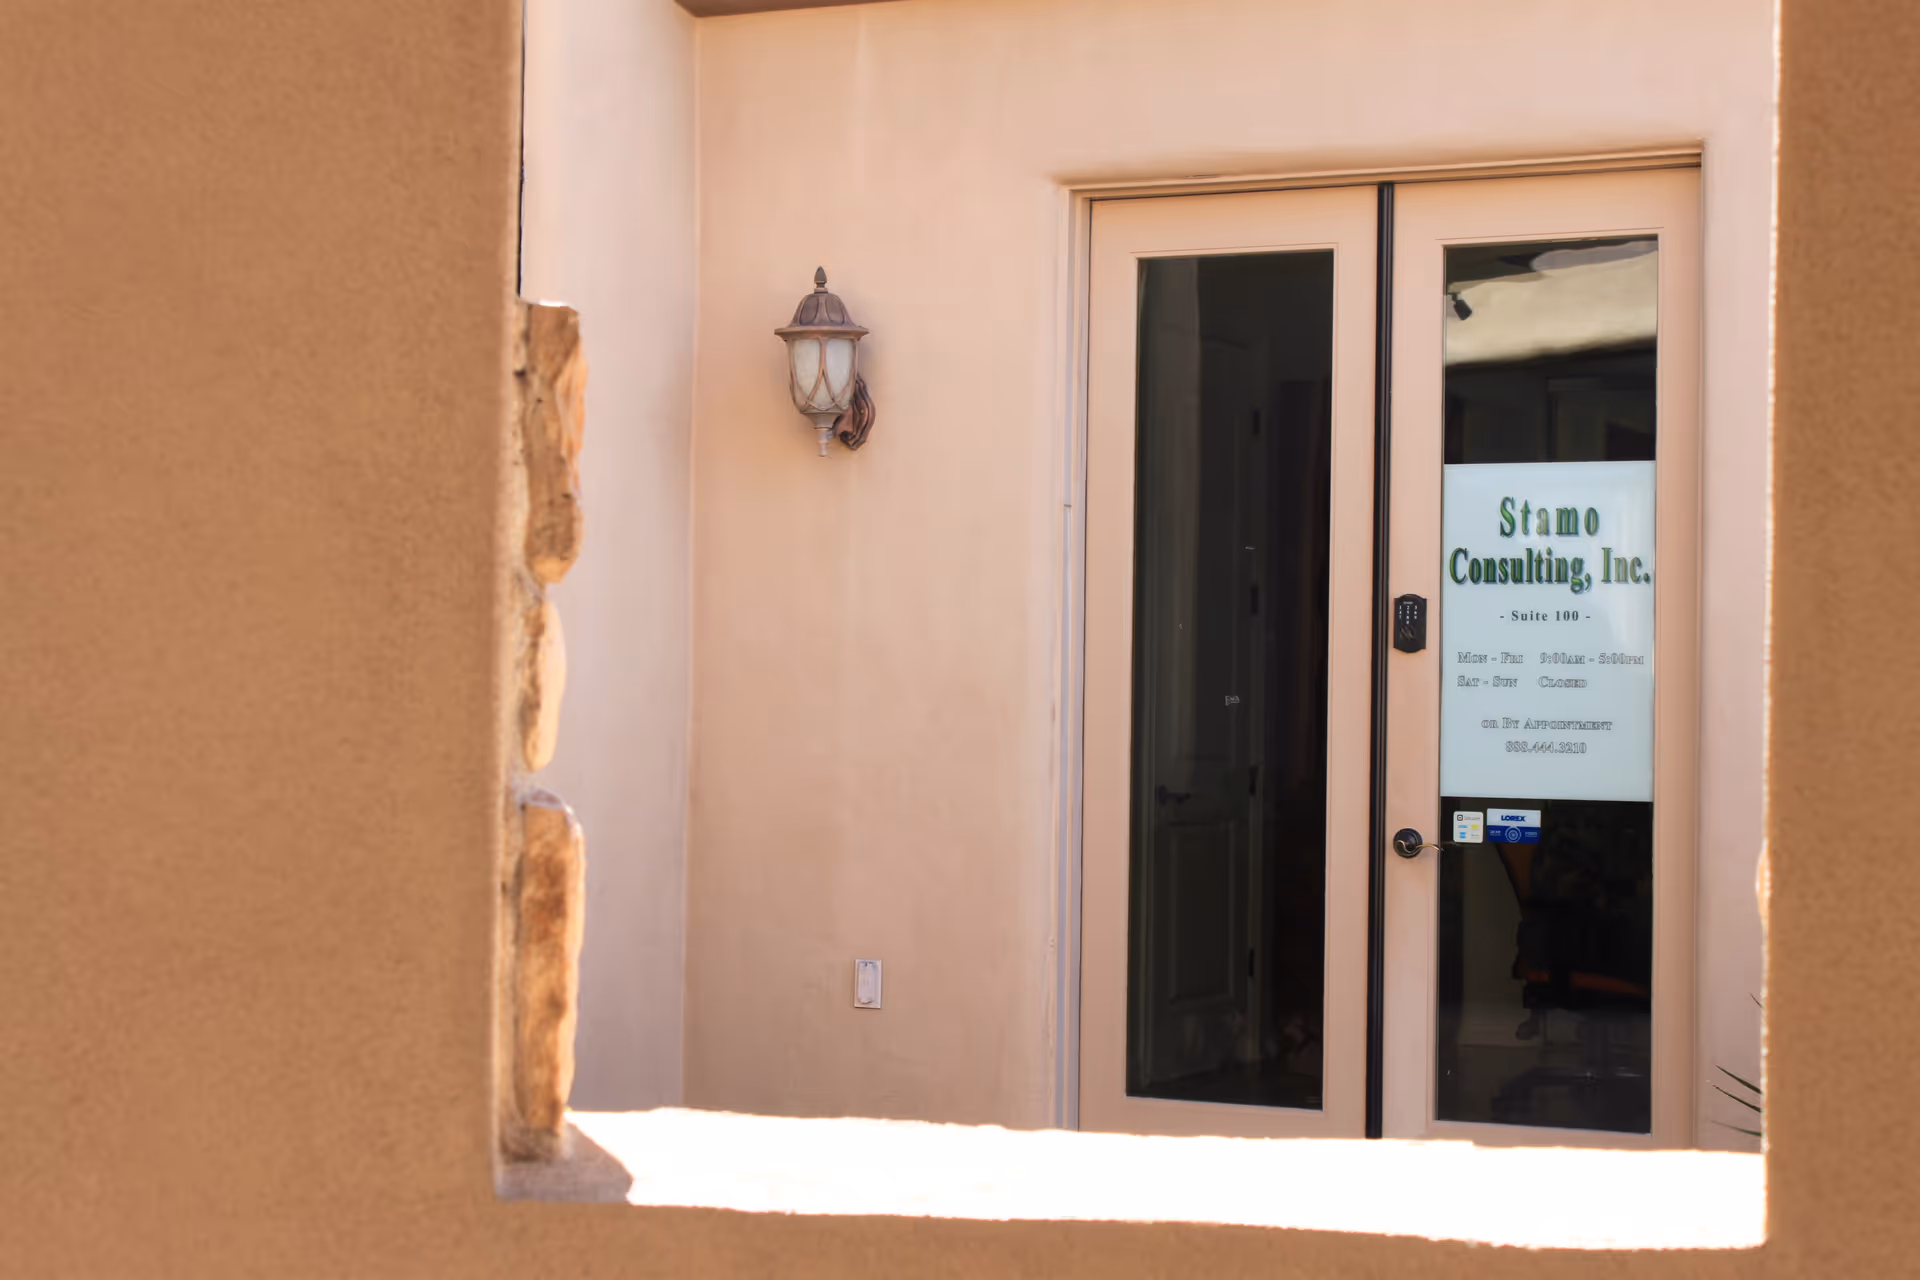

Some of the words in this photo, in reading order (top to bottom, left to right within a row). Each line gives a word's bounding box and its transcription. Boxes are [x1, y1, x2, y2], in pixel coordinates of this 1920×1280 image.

[1499, 496, 1600, 539] Stamo
[1449, 547, 1593, 595] Consulting,
[1600, 546, 1652, 585] Inc.
[1511, 610, 1548, 622] Suite
[1555, 610, 1579, 622] 100
[1505, 740, 1588, 754] 888.444.3210
[1500, 814, 1526, 823] LOREX
